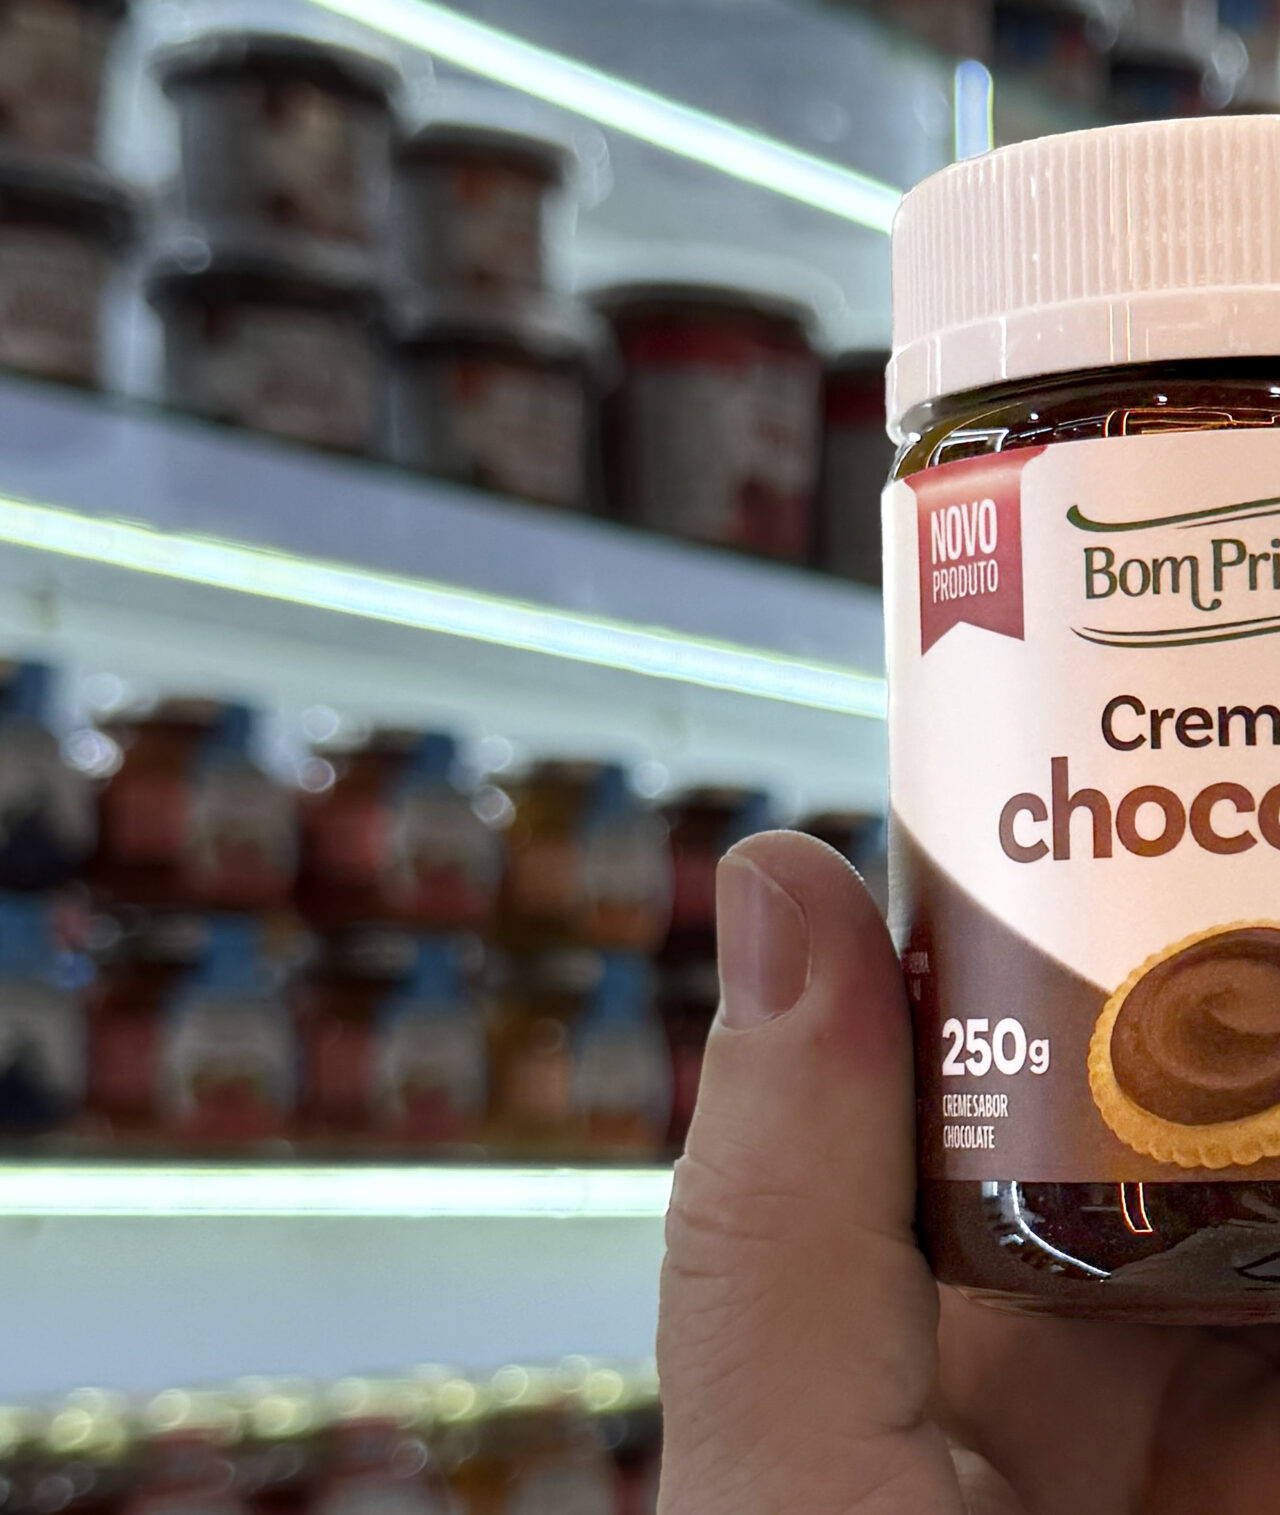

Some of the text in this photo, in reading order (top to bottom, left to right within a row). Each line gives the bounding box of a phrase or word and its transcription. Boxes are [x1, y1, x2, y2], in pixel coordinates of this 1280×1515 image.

[930, 498, 998, 565] NOVO
[932, 558, 999, 604] PRODUTO
[1084, 545, 1222, 612] Bom
[942, 1017, 1050, 1078] 250g
[943, 1125, 996, 1149] CHOCOLATE
